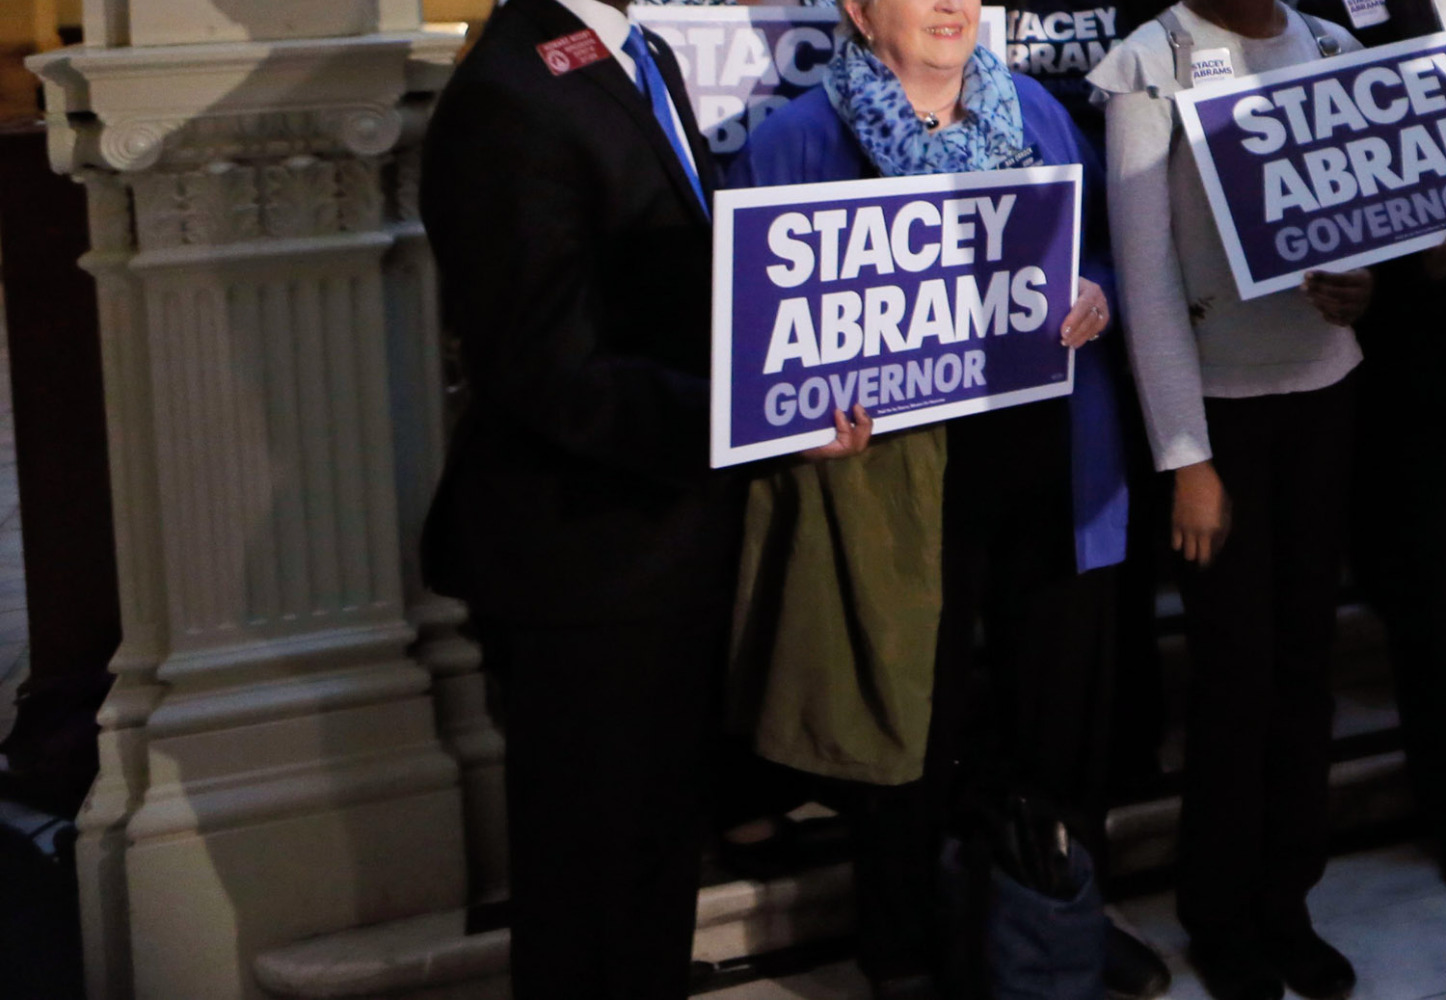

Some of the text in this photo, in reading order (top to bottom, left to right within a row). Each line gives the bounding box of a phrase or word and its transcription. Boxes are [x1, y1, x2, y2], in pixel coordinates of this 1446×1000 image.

[1007, 6, 1117, 41] TACEY
[654, 27, 833, 87] STAC
[1007, 40, 1108, 74] BRA
[1191, 59, 1224, 70] STACEY
[1193, 66, 1233, 79] ABRAMS
[765, 194, 1018, 289] STACEY
[762, 265, 1049, 375] ABRAMS
[763, 349, 988, 427] GOVERNOR
